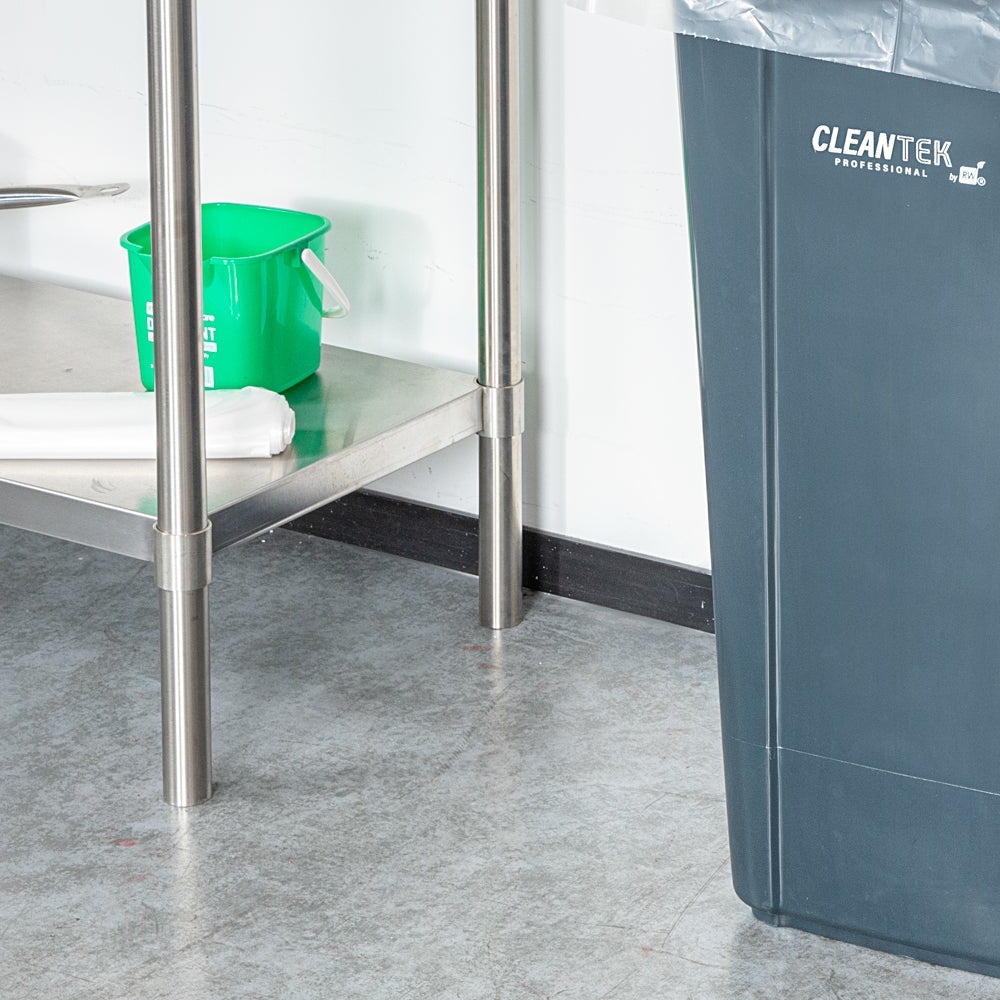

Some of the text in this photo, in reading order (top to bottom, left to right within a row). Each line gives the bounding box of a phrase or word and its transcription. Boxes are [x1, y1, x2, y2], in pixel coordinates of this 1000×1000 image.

[812, 124, 952, 167] CLEANTEK
[834, 157, 928, 178] PROFESSIONAL
[949, 172, 958, 184] by
